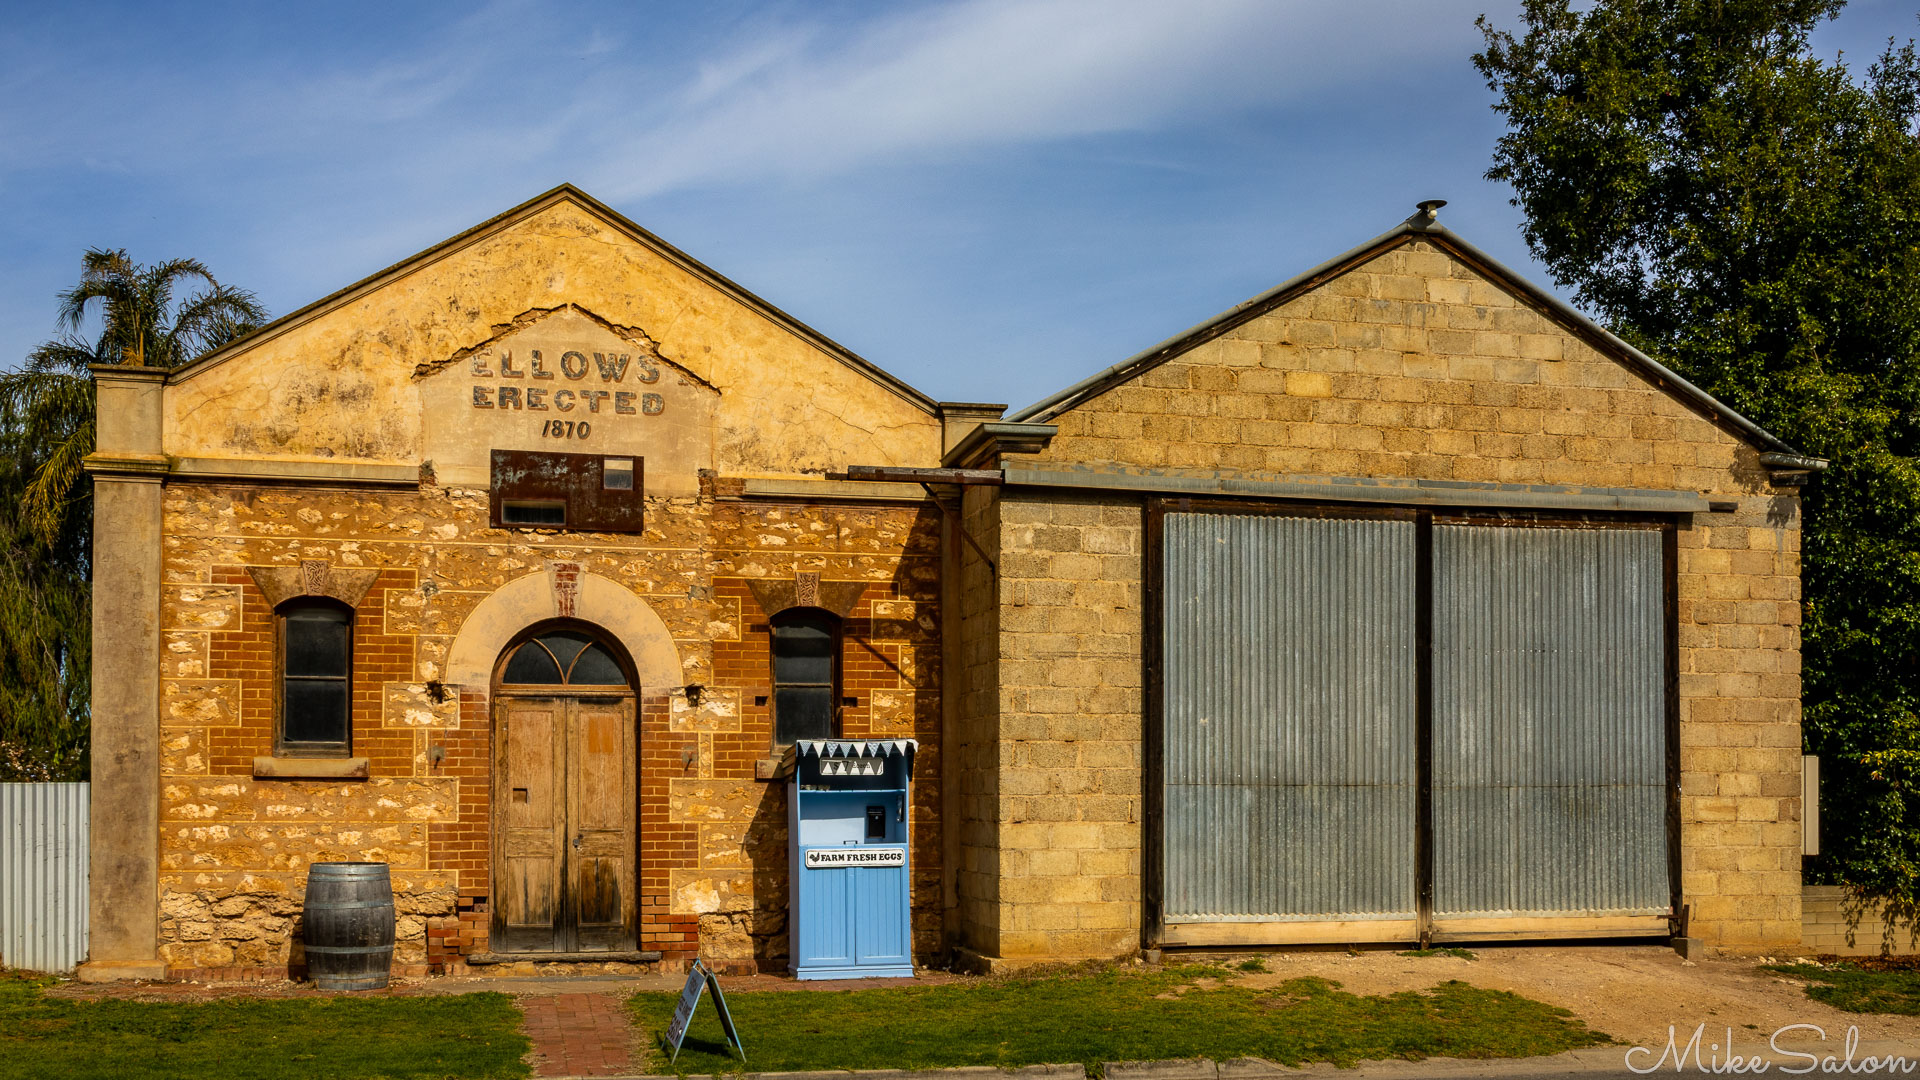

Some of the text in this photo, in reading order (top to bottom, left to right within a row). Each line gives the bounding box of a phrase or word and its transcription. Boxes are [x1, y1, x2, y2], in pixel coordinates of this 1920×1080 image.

[470, 348, 660, 385] ELLOWS
[472, 385, 665, 416] ERECTED
[542, 419, 592, 440] 1870
[820, 853, 903, 862] FARM FRESH EGGS
